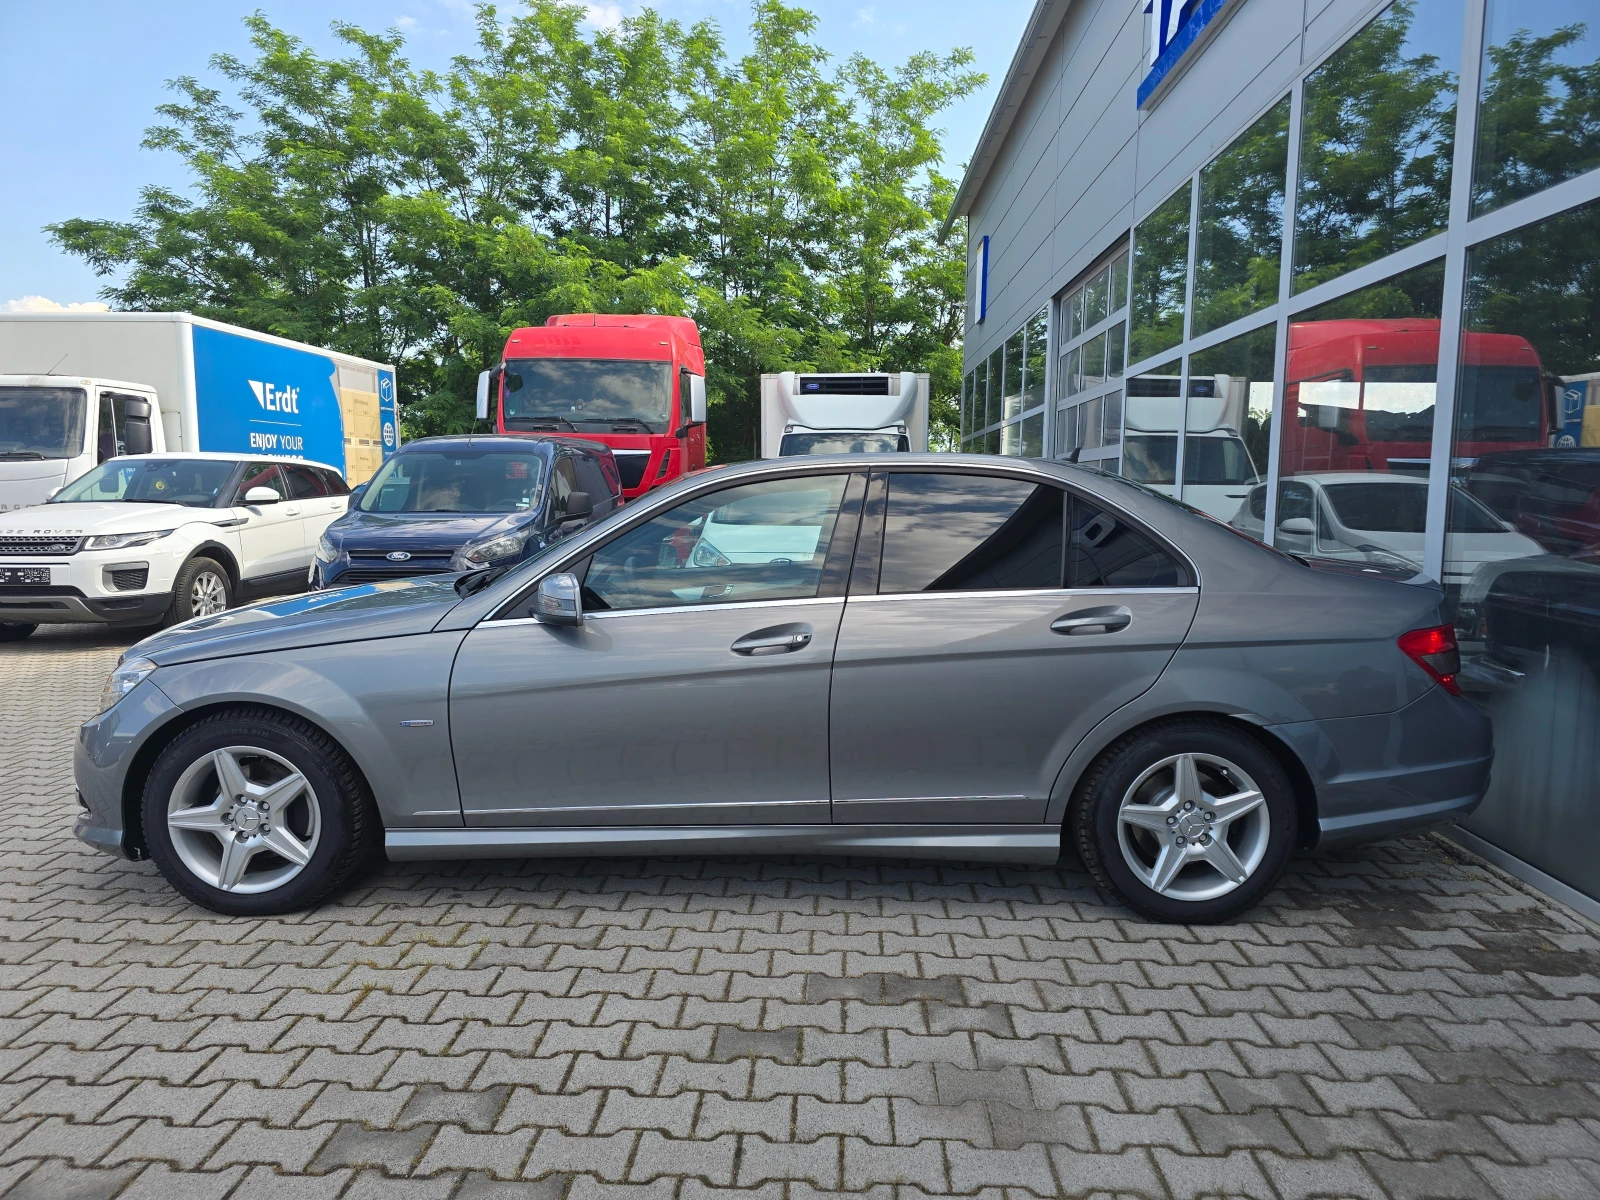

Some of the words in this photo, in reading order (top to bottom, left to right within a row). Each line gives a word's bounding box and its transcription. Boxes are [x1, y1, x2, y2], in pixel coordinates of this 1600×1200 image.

[265, 383, 299, 414] Erdt
[250, 432, 278, 451] ENJOY
[280, 435, 303, 450] YOUR
